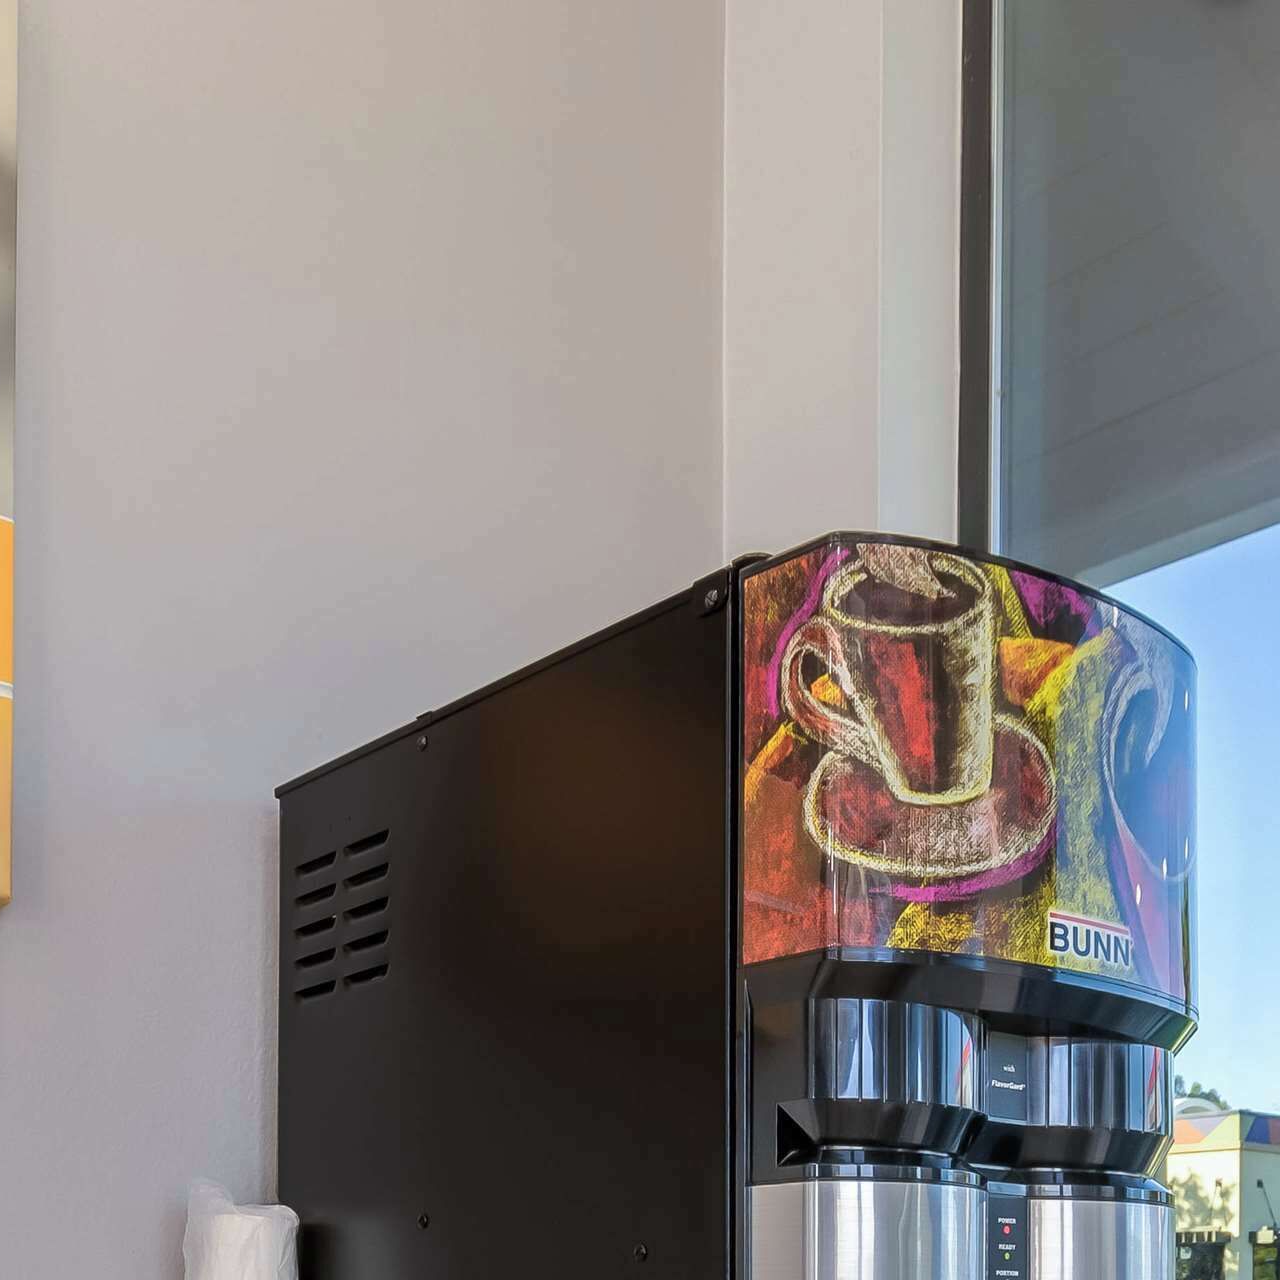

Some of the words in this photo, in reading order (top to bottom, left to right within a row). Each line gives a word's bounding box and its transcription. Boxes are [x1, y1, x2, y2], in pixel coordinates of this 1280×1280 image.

[1049, 921, 1130, 967] BUNN
[997, 1217, 1017, 1225] POWER
[998, 1243, 1017, 1251] READY
[995, 1269, 1019, 1277] PORTION
